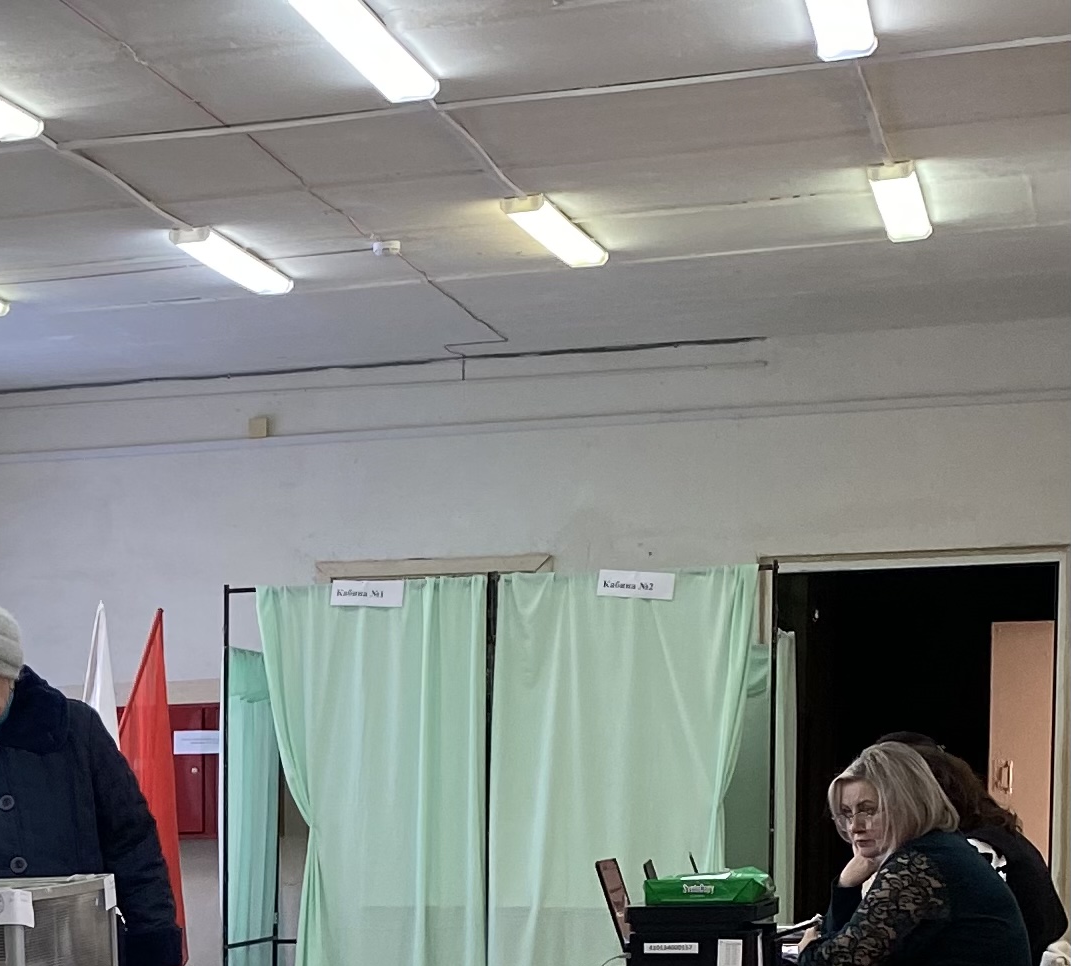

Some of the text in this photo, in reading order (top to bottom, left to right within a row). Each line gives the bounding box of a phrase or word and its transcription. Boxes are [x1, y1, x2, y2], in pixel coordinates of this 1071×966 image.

[602, 580, 654, 591] Кабина №2
[336, 588, 368, 597] Кабина
